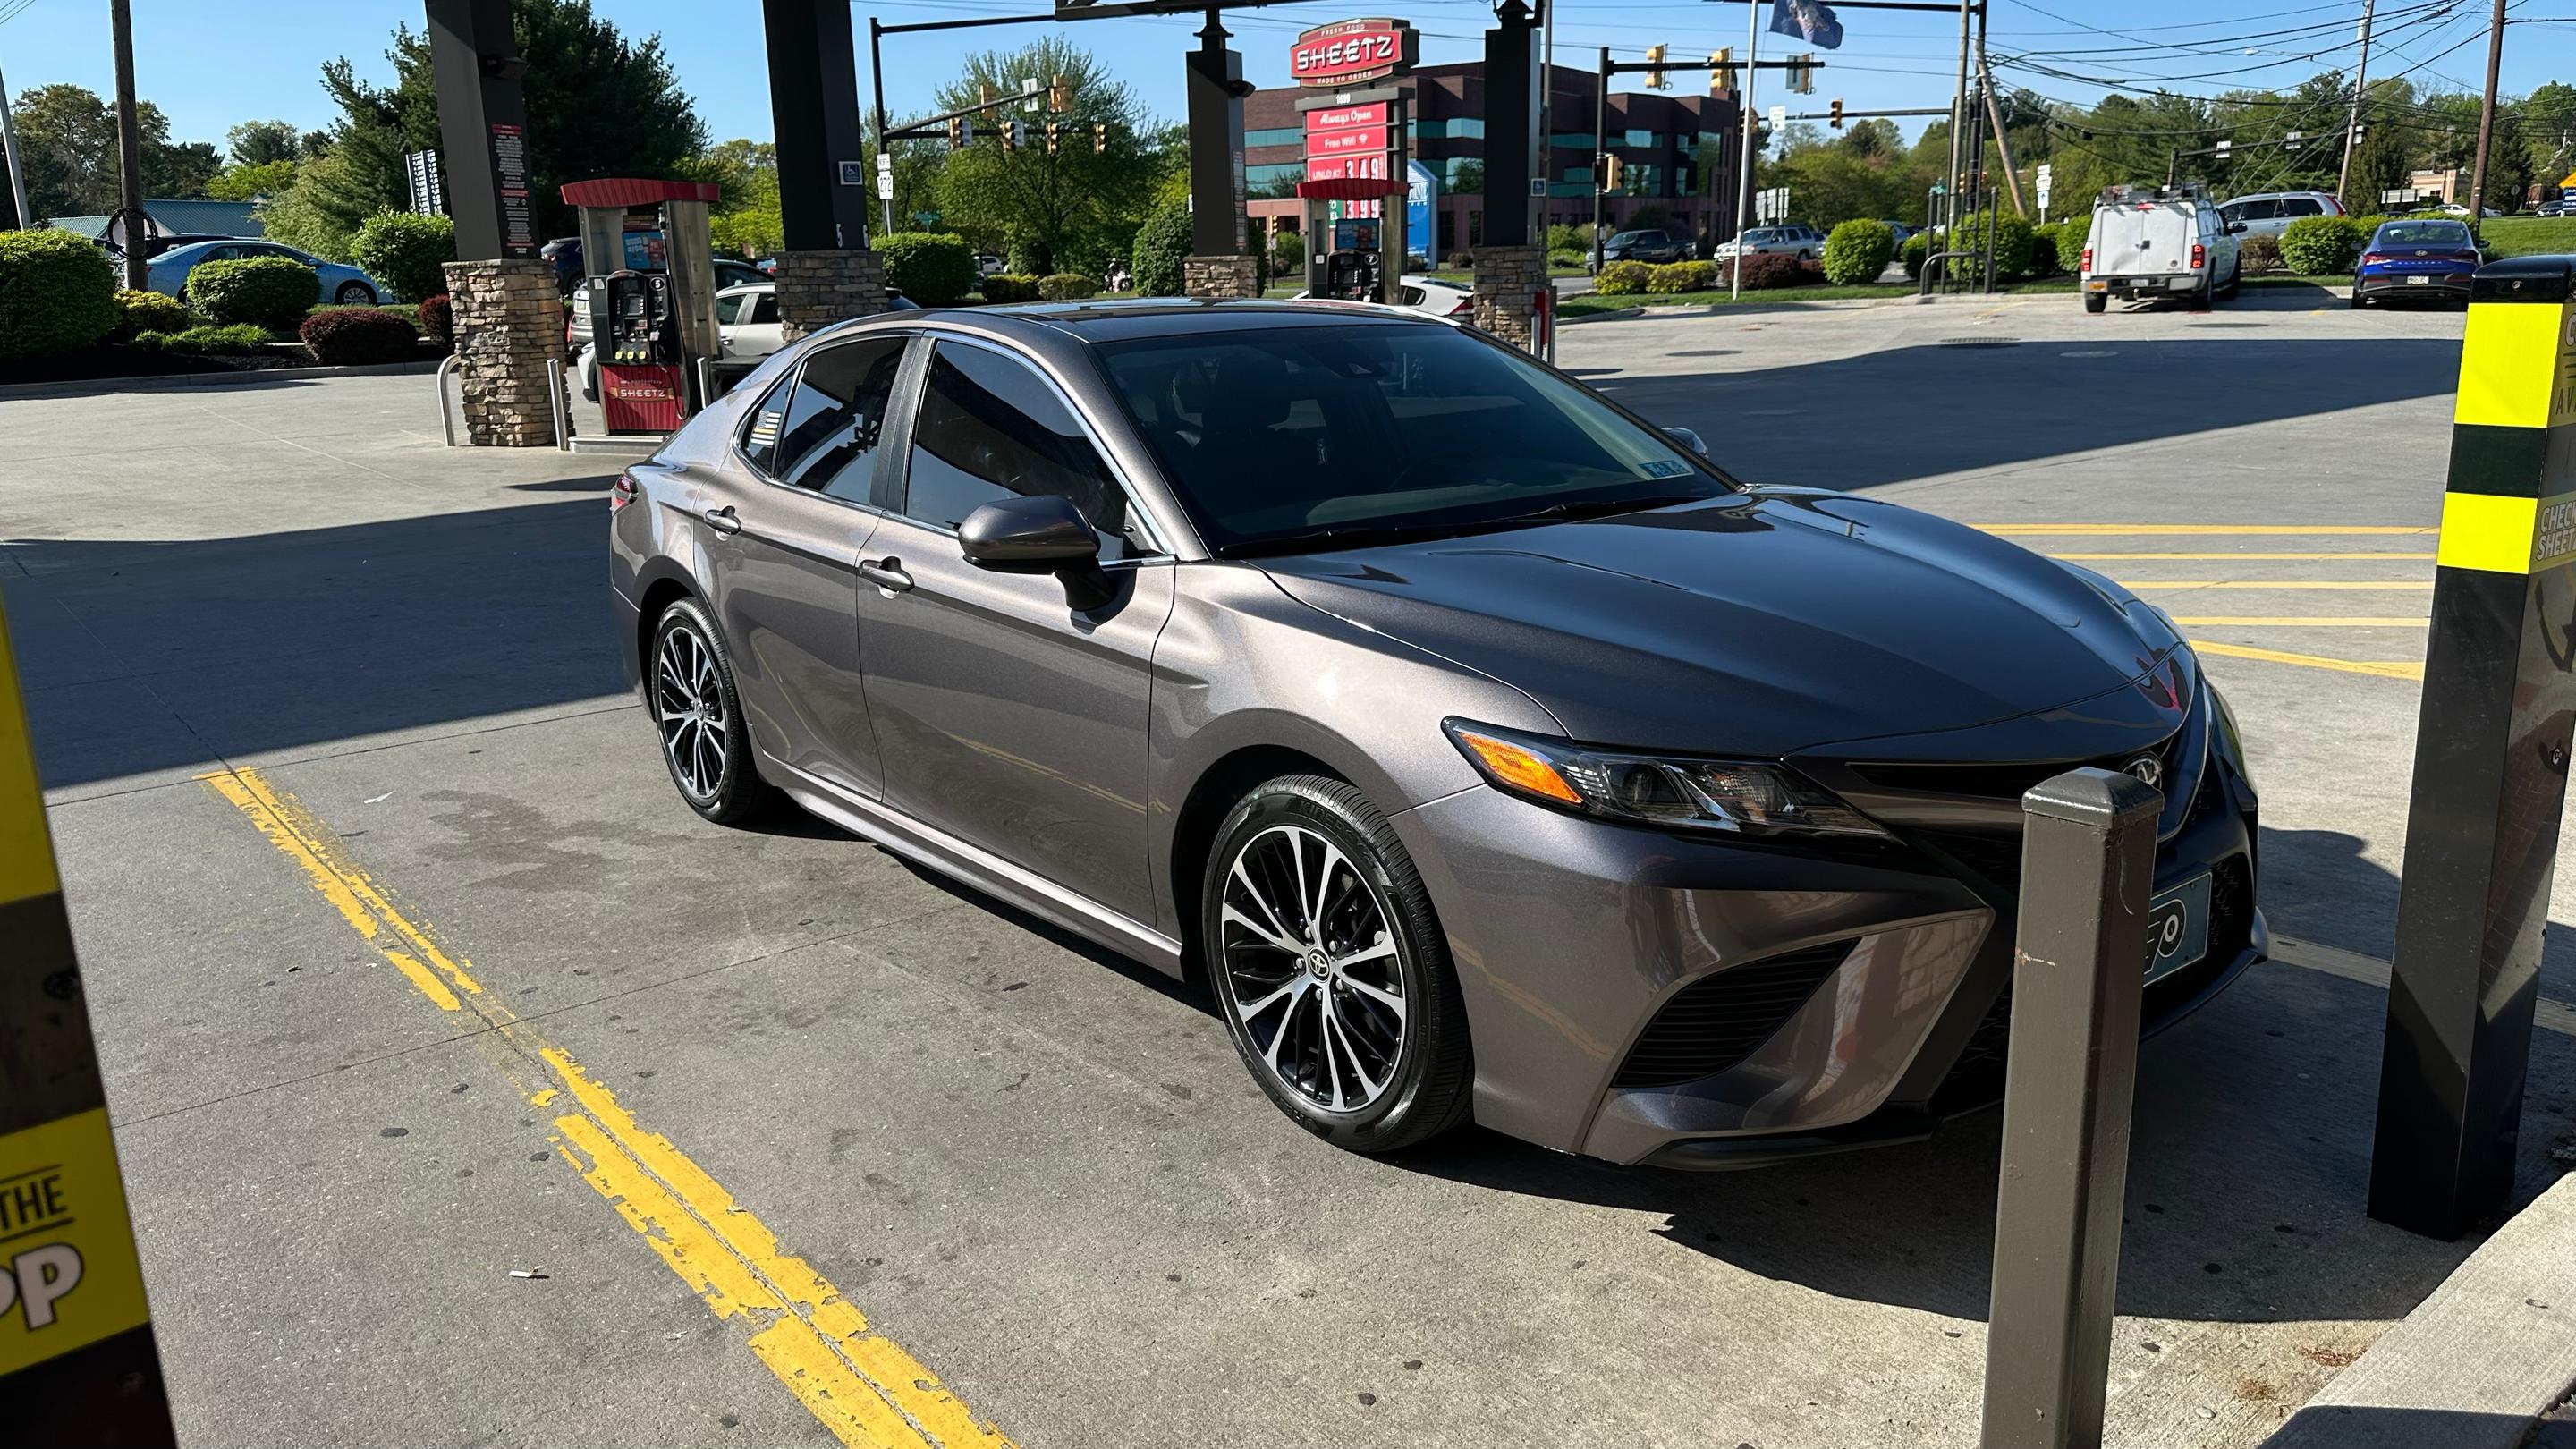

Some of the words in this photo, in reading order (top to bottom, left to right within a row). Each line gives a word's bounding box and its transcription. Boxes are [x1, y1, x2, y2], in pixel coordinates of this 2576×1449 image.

[1297, 35, 1393, 71] SHEETZ
[1348, 71, 1372, 81] ORDER
[1320, 113, 1350, 125] Always
[1351, 110, 1372, 123] Open
[1325, 139, 1341, 148] Free
[879, 176, 892, 192] 272
[836, 224, 843, 248] 5
[620, 389, 665, 397] SHEETZ
[0, 1174, 68, 1231] THE
